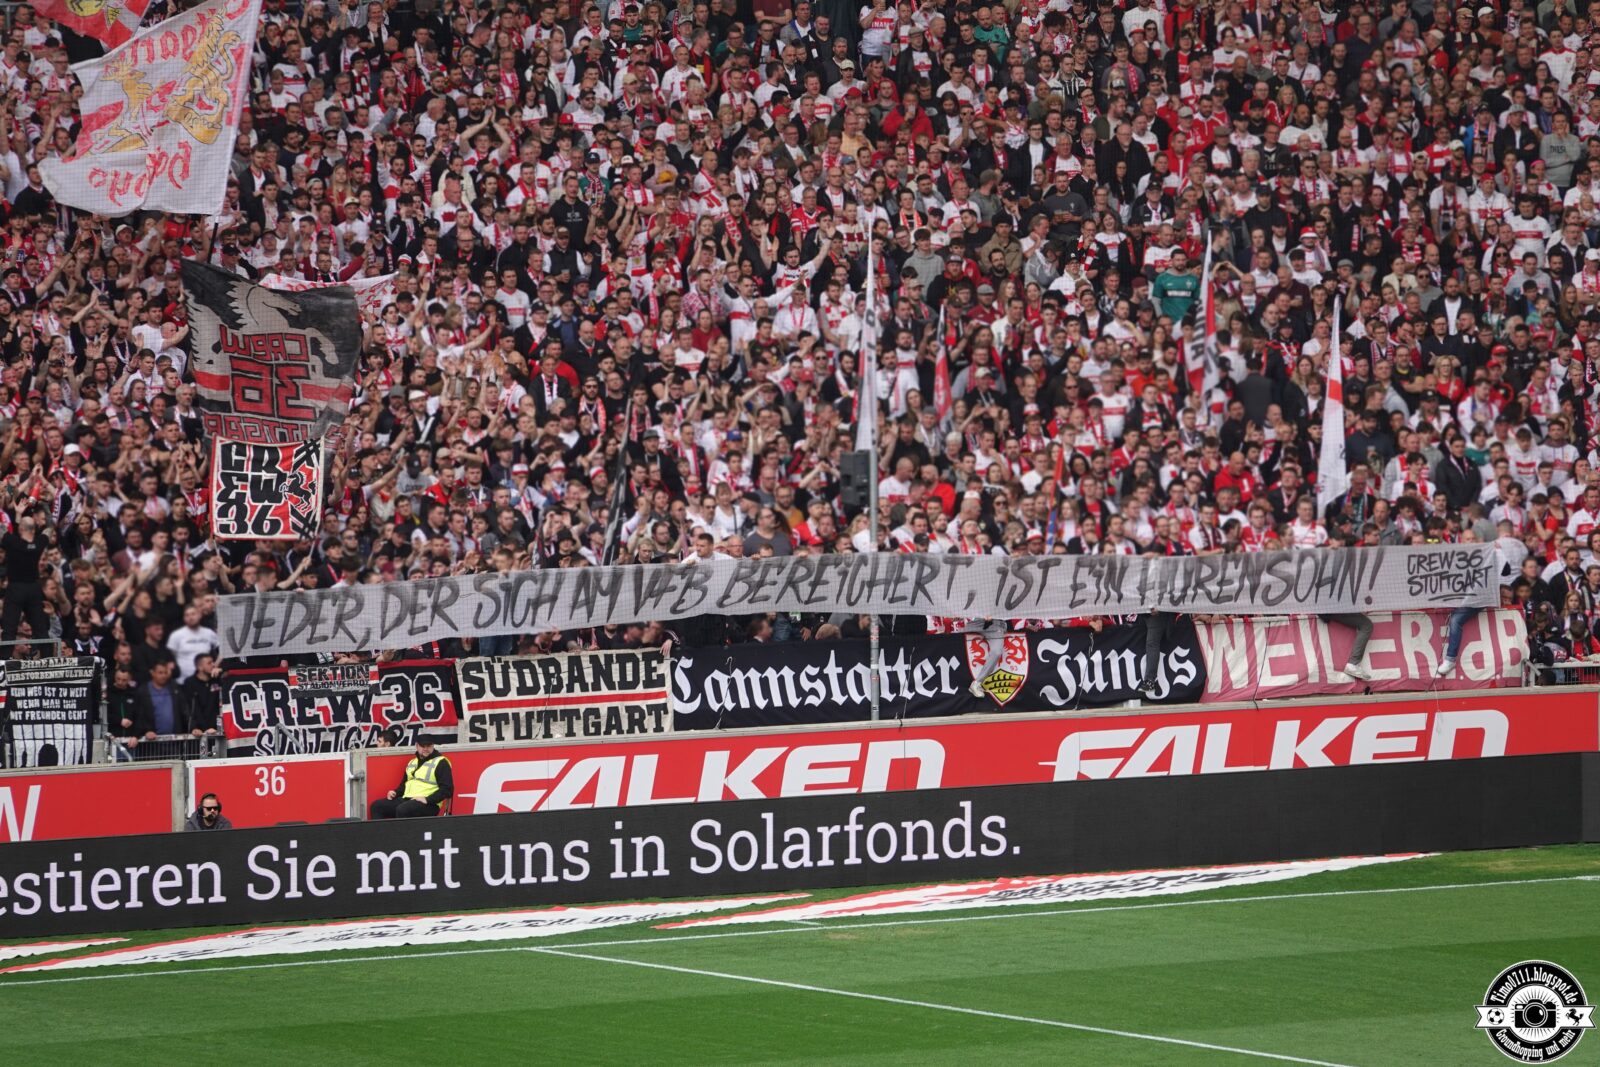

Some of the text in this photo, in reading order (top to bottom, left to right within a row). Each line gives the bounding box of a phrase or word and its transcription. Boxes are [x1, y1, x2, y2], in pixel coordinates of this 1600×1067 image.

[217, 502, 281, 536] 36
[1407, 565, 1493, 596] STUTTGART
[226, 592, 371, 654] JEDER,
[380, 578, 459, 640] DER
[569, 564, 627, 624] AM
[48, 657, 78, 667] ALLEN
[1195, 609, 1436, 693] WEILER
[65, 669, 93, 678] ULTRAS
[296, 665, 369, 682] SEKTION
[461, 650, 666, 700] SÜDBANDE
[673, 647, 961, 714] Cannstatter
[27, 686, 42, 697] WEG
[44, 687, 56, 697] IST
[230, 671, 445, 732] CREW 36
[25, 710, 66, 720] FREUNDEN
[469, 702, 669, 742] STUTTGART
[254, 765, 286, 797] 36
[0, 800, 1021, 916] stieren Sie mit uns in Solarfonds.
